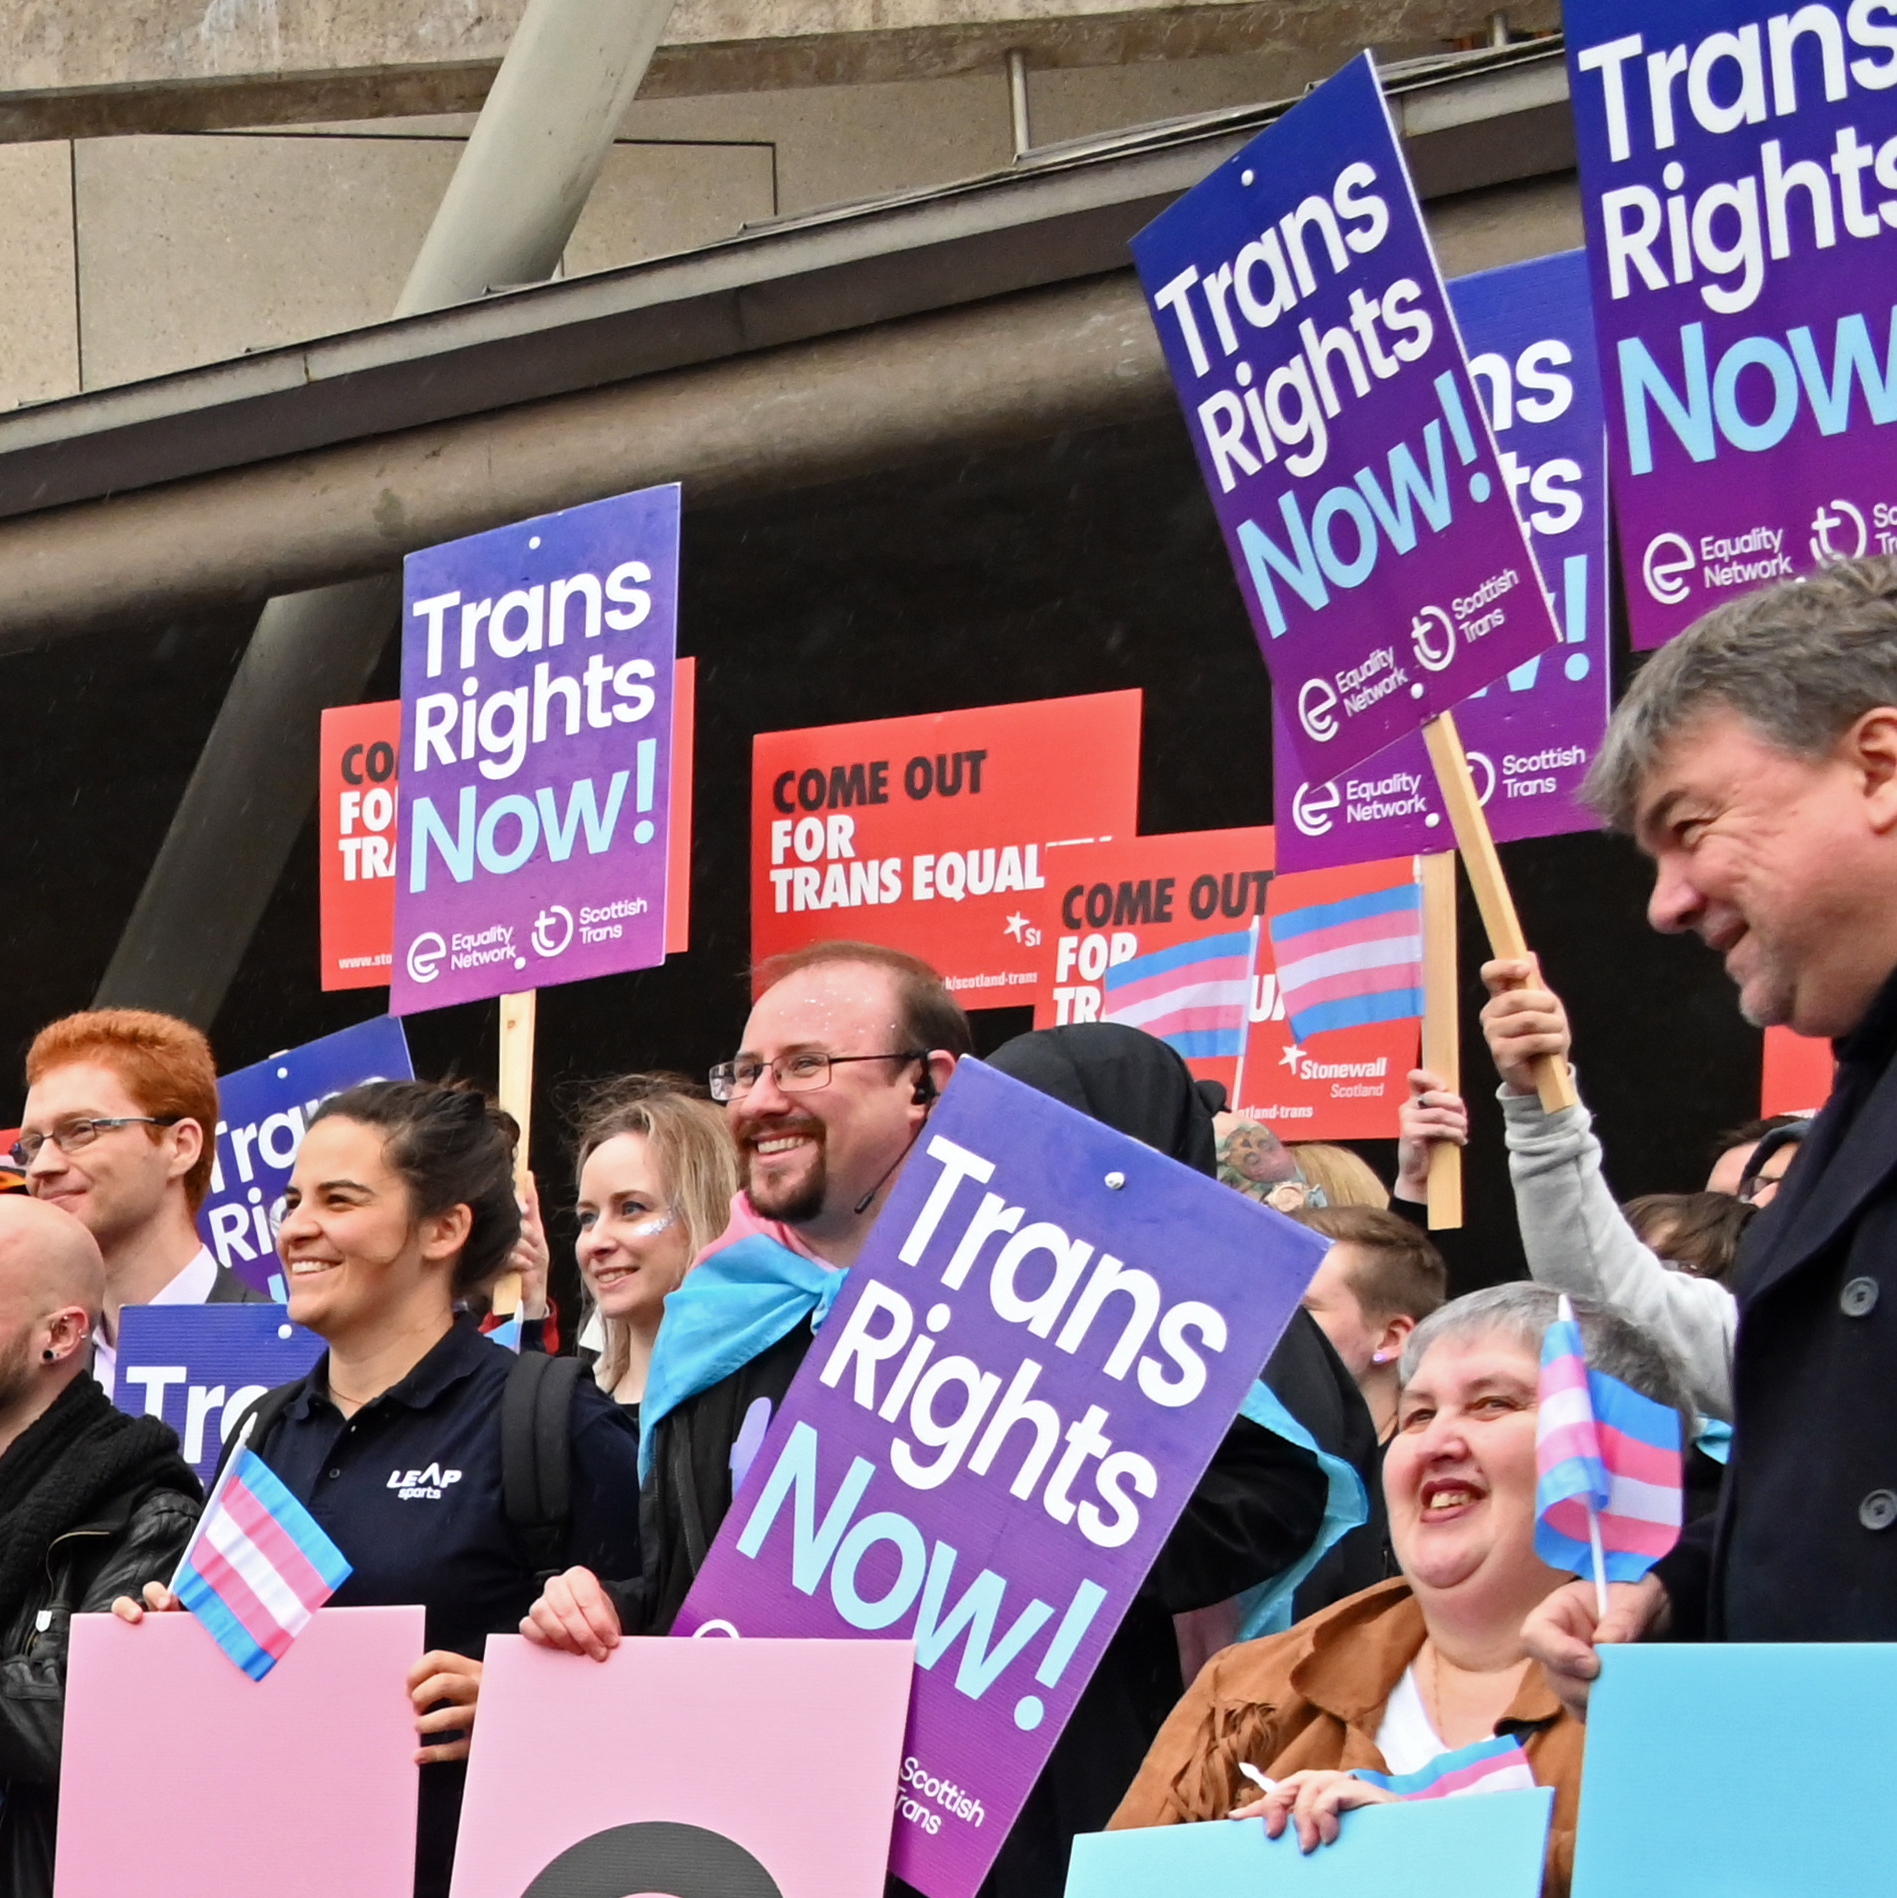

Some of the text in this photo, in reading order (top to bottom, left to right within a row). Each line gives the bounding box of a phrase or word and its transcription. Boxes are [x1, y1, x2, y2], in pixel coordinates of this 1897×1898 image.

[1579, 0, 1897, 162] Trans
[1154, 161, 1390, 379] Trans
[1197, 278, 1435, 494] Rights
[1236, 370, 1491, 640] Now!
[1701, 527, 1784, 562] Equality
[1704, 553, 1793, 586] Network
[413, 561, 652, 677] Trans
[1451, 568, 1519, 621] Scottish
[1459, 607, 1505, 644] Trans
[1334, 645, 1394, 696] Equality
[1344, 674, 1408, 716] Network
[414, 653, 655, 772] Rights
[772, 749, 987, 813] COME OUT
[1502, 746, 1586, 774] Scottish
[1346, 774, 1422, 802] Equality
[1346, 795, 1426, 823] Network
[1502, 774, 1556, 797] Trans
[339, 786, 398, 835] FO
[410, 738, 656, 893] Now!
[771, 814, 854, 865] FOR
[770, 857, 902, 913] TRANS
[1061, 868, 1276, 930] COME OUT
[579, 897, 648, 925] Scottish
[580, 922, 622, 944] Trans
[338, 952, 393, 969] www.sto
[451, 943, 516, 971] Network
[452, 925, 513, 951] Equality
[1300, 1057, 1387, 1080] Stonewall
[1330, 1083, 1384, 1098] Scotland
[896, 1134, 1228, 1408] Trans
[819, 1279, 1158, 1548] Rights
[387, 1462, 461, 1488] LEAP
[398, 1484, 441, 1500] sports
[736, 1421, 1107, 1732] Now!
[899, 1756, 985, 1827] Scottish
